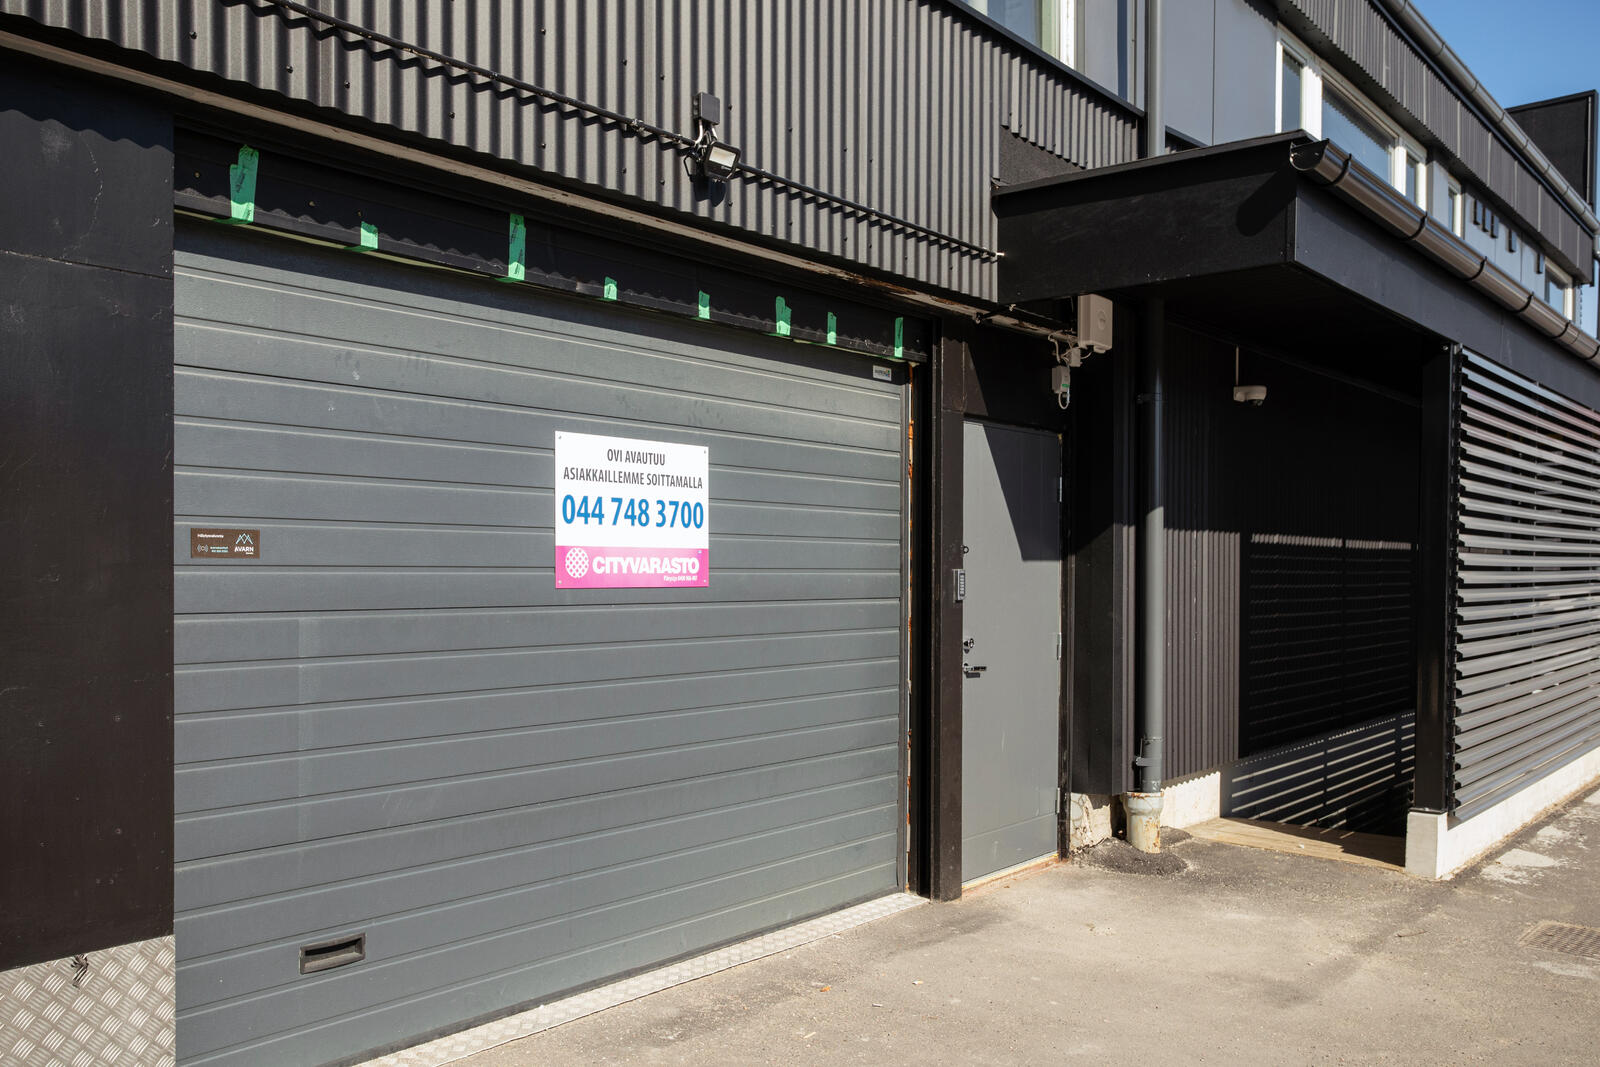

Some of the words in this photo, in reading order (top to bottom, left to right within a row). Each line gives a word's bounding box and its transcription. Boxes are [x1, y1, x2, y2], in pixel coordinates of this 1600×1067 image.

[607, 449, 623, 462] OVI
[624, 450, 666, 466] AVAUTUU
[563, 466, 645, 486] ASIAKKAILLEMME
[646, 473, 703, 489] SOITTAMALLA
[562, 494, 605, 525] 044
[610, 497, 650, 527] 748
[655, 499, 704, 529] 3700
[592, 556, 700, 574] CITYVARASTO
